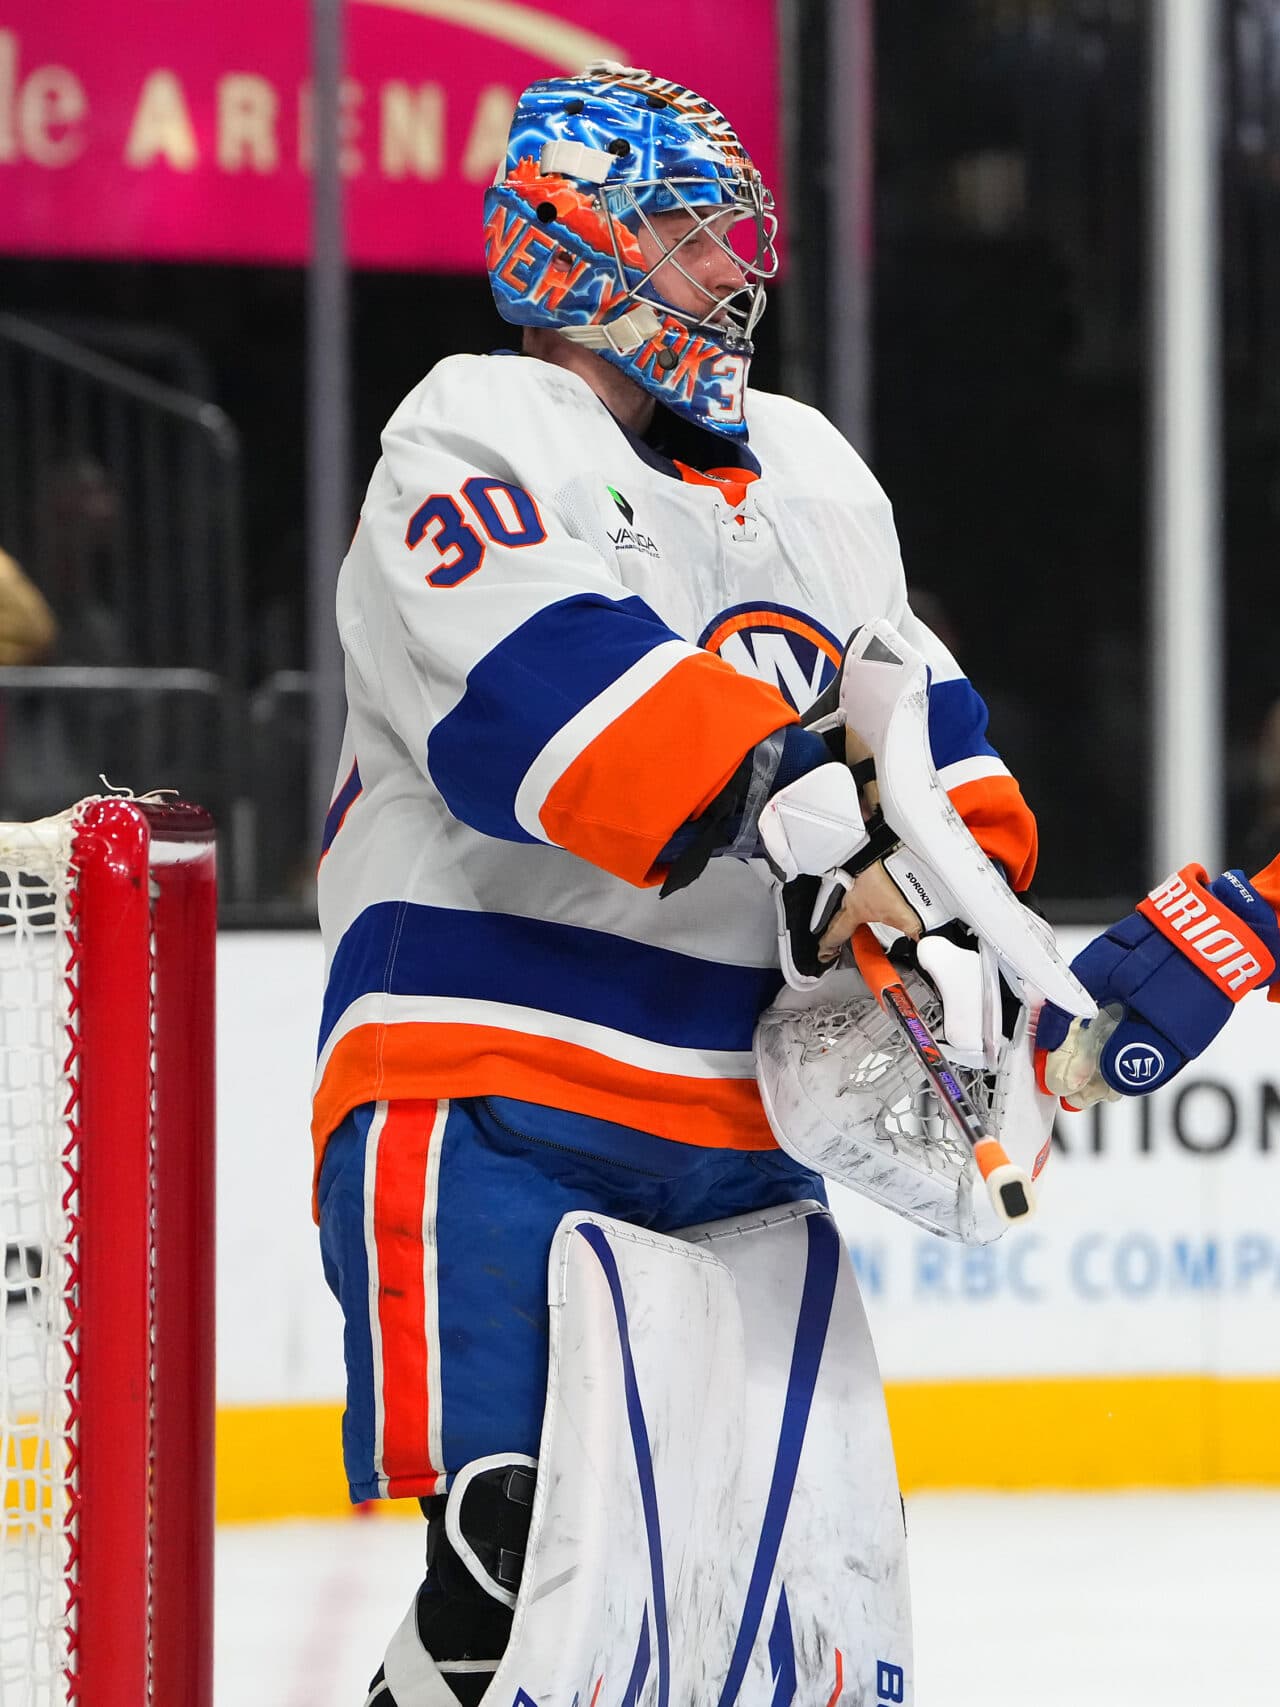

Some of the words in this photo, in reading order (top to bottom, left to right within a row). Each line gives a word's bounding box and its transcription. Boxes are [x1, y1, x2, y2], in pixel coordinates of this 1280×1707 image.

[484, 203, 591, 312] NEW
[588, 272, 724, 402] YRK
[706, 353, 750, 425] 3
[404, 476, 548, 589] 30
[905, 872, 932, 907] SOROKIN
[1148, 872, 1262, 991] RRIOR
[914, 1237, 1044, 1300] RBC
